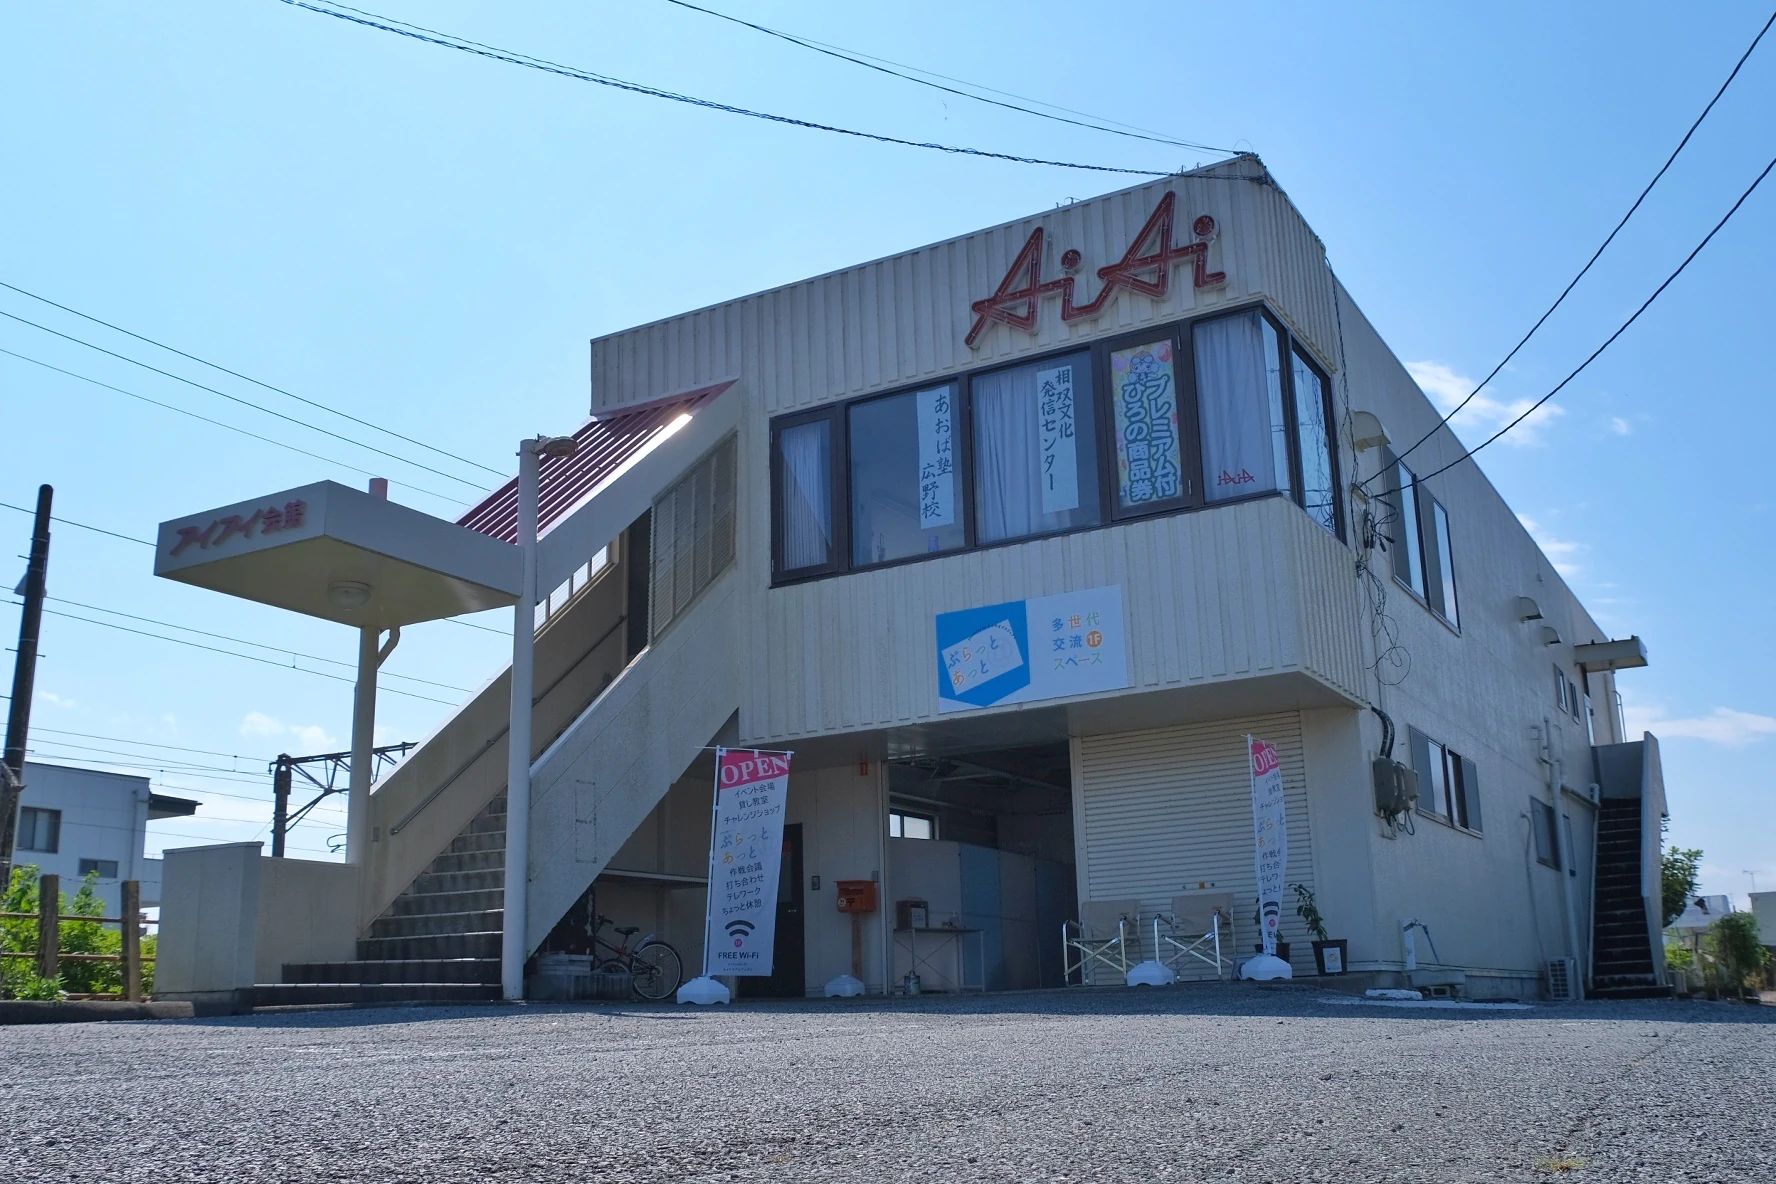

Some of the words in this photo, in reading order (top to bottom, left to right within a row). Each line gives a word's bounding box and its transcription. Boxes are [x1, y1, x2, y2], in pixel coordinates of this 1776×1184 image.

[1055, 369, 1074, 439] 相双文化
[934, 393, 953, 477] あおば塾
[1040, 380, 1057, 491] 発信センター
[1121, 382, 1154, 502] ひろの商品券
[1145, 373, 1177, 498] プレミアム付
[921, 462, 942, 519] 広野校
[1052, 612, 1100, 632] 多世代
[952, 660, 989, 686] あっと
[1054, 652, 1103, 670] スペース
[721, 756, 788, 784] OPEN
[735, 782, 775, 798] イベント会場
[724, 805, 780, 824] チャレンジショップ
[726, 875, 764, 890] 打ち合わせ
[729, 862, 762, 877] 作戦会議
[727, 887, 761, 901] テレワーク
